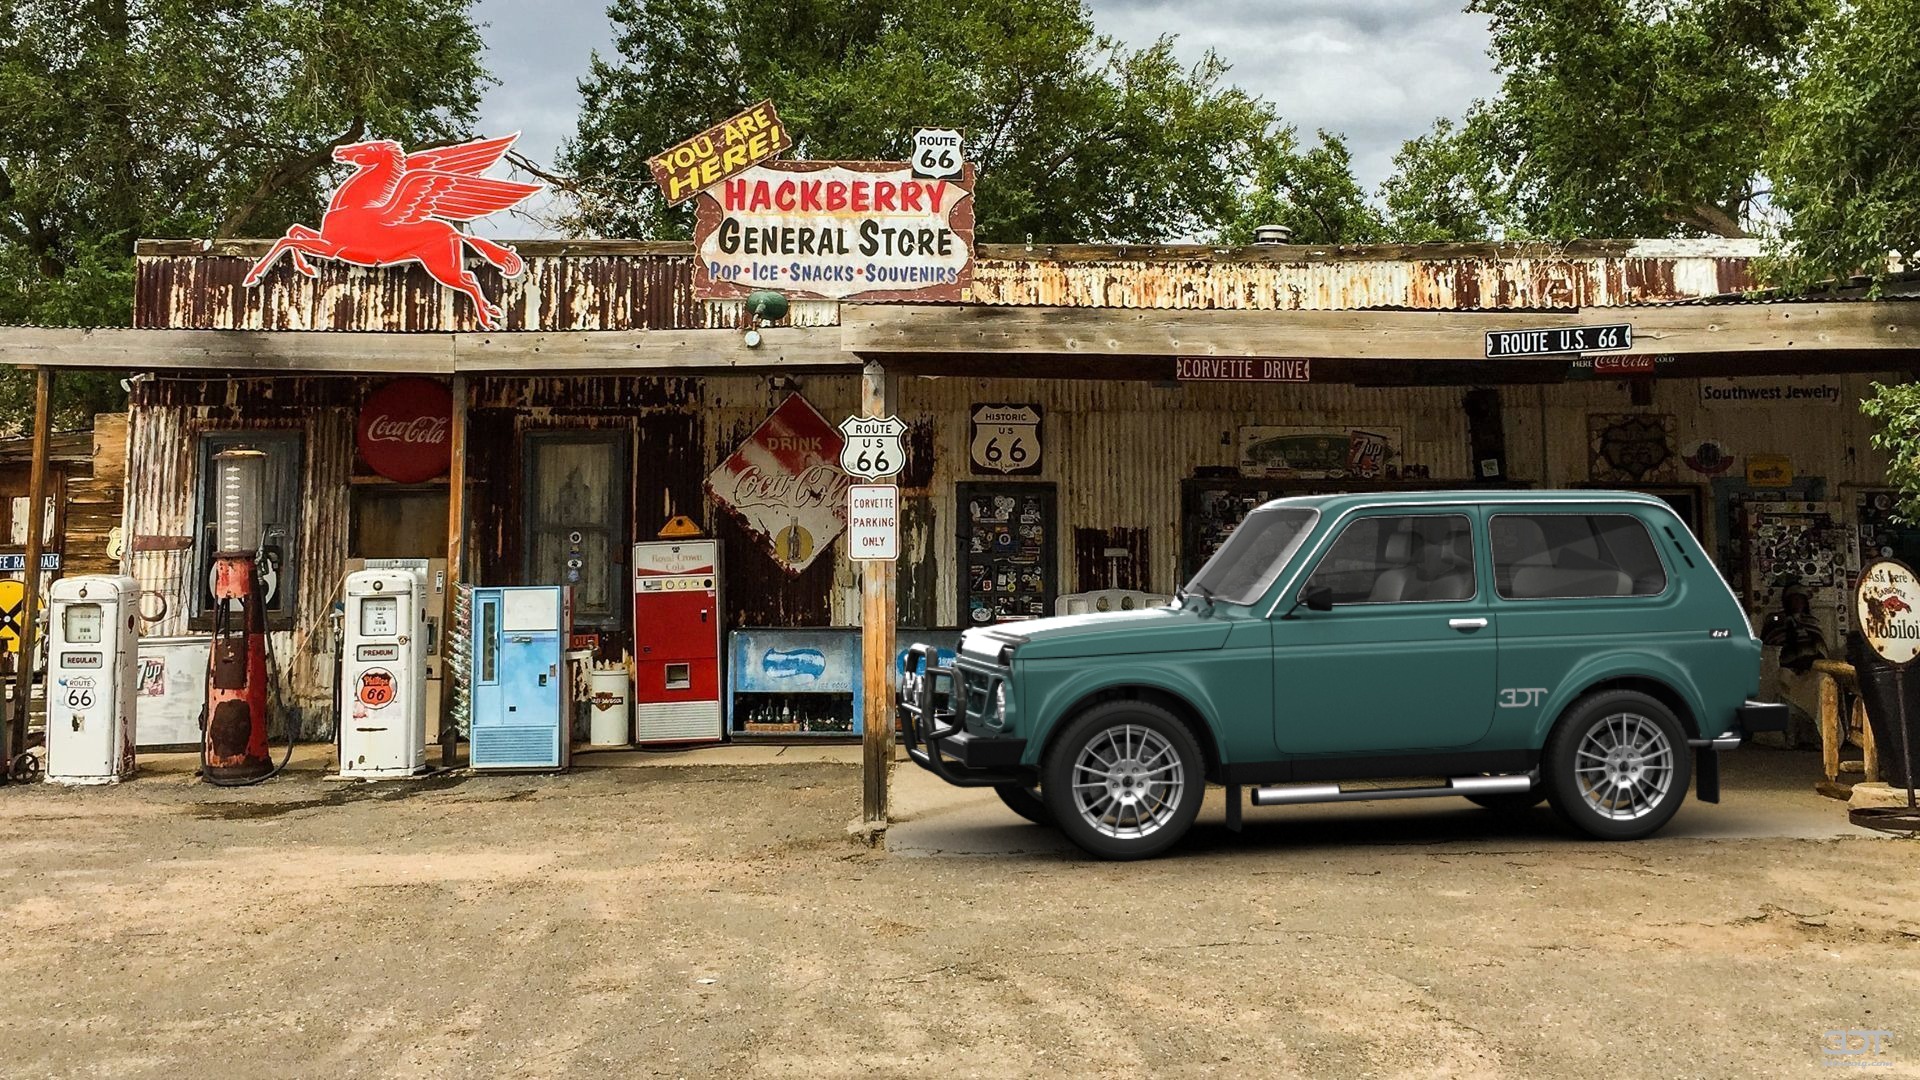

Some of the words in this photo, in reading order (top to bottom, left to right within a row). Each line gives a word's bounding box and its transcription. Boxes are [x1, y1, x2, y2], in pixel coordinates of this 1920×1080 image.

[658, 137, 714, 175] YOU
[724, 107, 771, 146] ARE
[919, 136, 957, 147] ROUTE
[670, 125, 780, 200] HERE!
[920, 149, 955, 169] 66
[724, 180, 948, 213] HACKBERRY
[718, 217, 850, 256] GENERAL
[859, 219, 952, 257] STORE
[1501, 331, 1549, 353] ROUTE
[1560, 330, 1589, 350] U.S.
[1598, 328, 1618, 348] 66
[1654, 355, 1675, 363] COLD
[1183, 360, 1253, 379] CORVETTE
[1264, 360, 1304, 379] DRIVE
[1704, 386, 1781, 400] Southwest
[1786, 384, 1840, 402] Jewelry
[985, 413, 1027, 421] HISTORIC
[855, 424, 892, 434] ROUTE
[998, 427, 1014, 435] US
[767, 437, 823, 450] DRINK
[863, 439, 884, 448] US
[985, 437, 1027, 462] 66
[857, 450, 890, 472] 66
[854, 498, 894, 508] CORVETTE
[853, 518, 895, 527] PARKING
[862, 537, 886, 547] ONLY
[652, 554, 673, 563] Royal
[677, 553, 704, 561] Crown
[1869, 573, 1885, 582] Ask
[1866, 619, 1920, 640] Mobiloi
[68, 689, 92, 706] 66
[367, 688, 386, 701] 66
